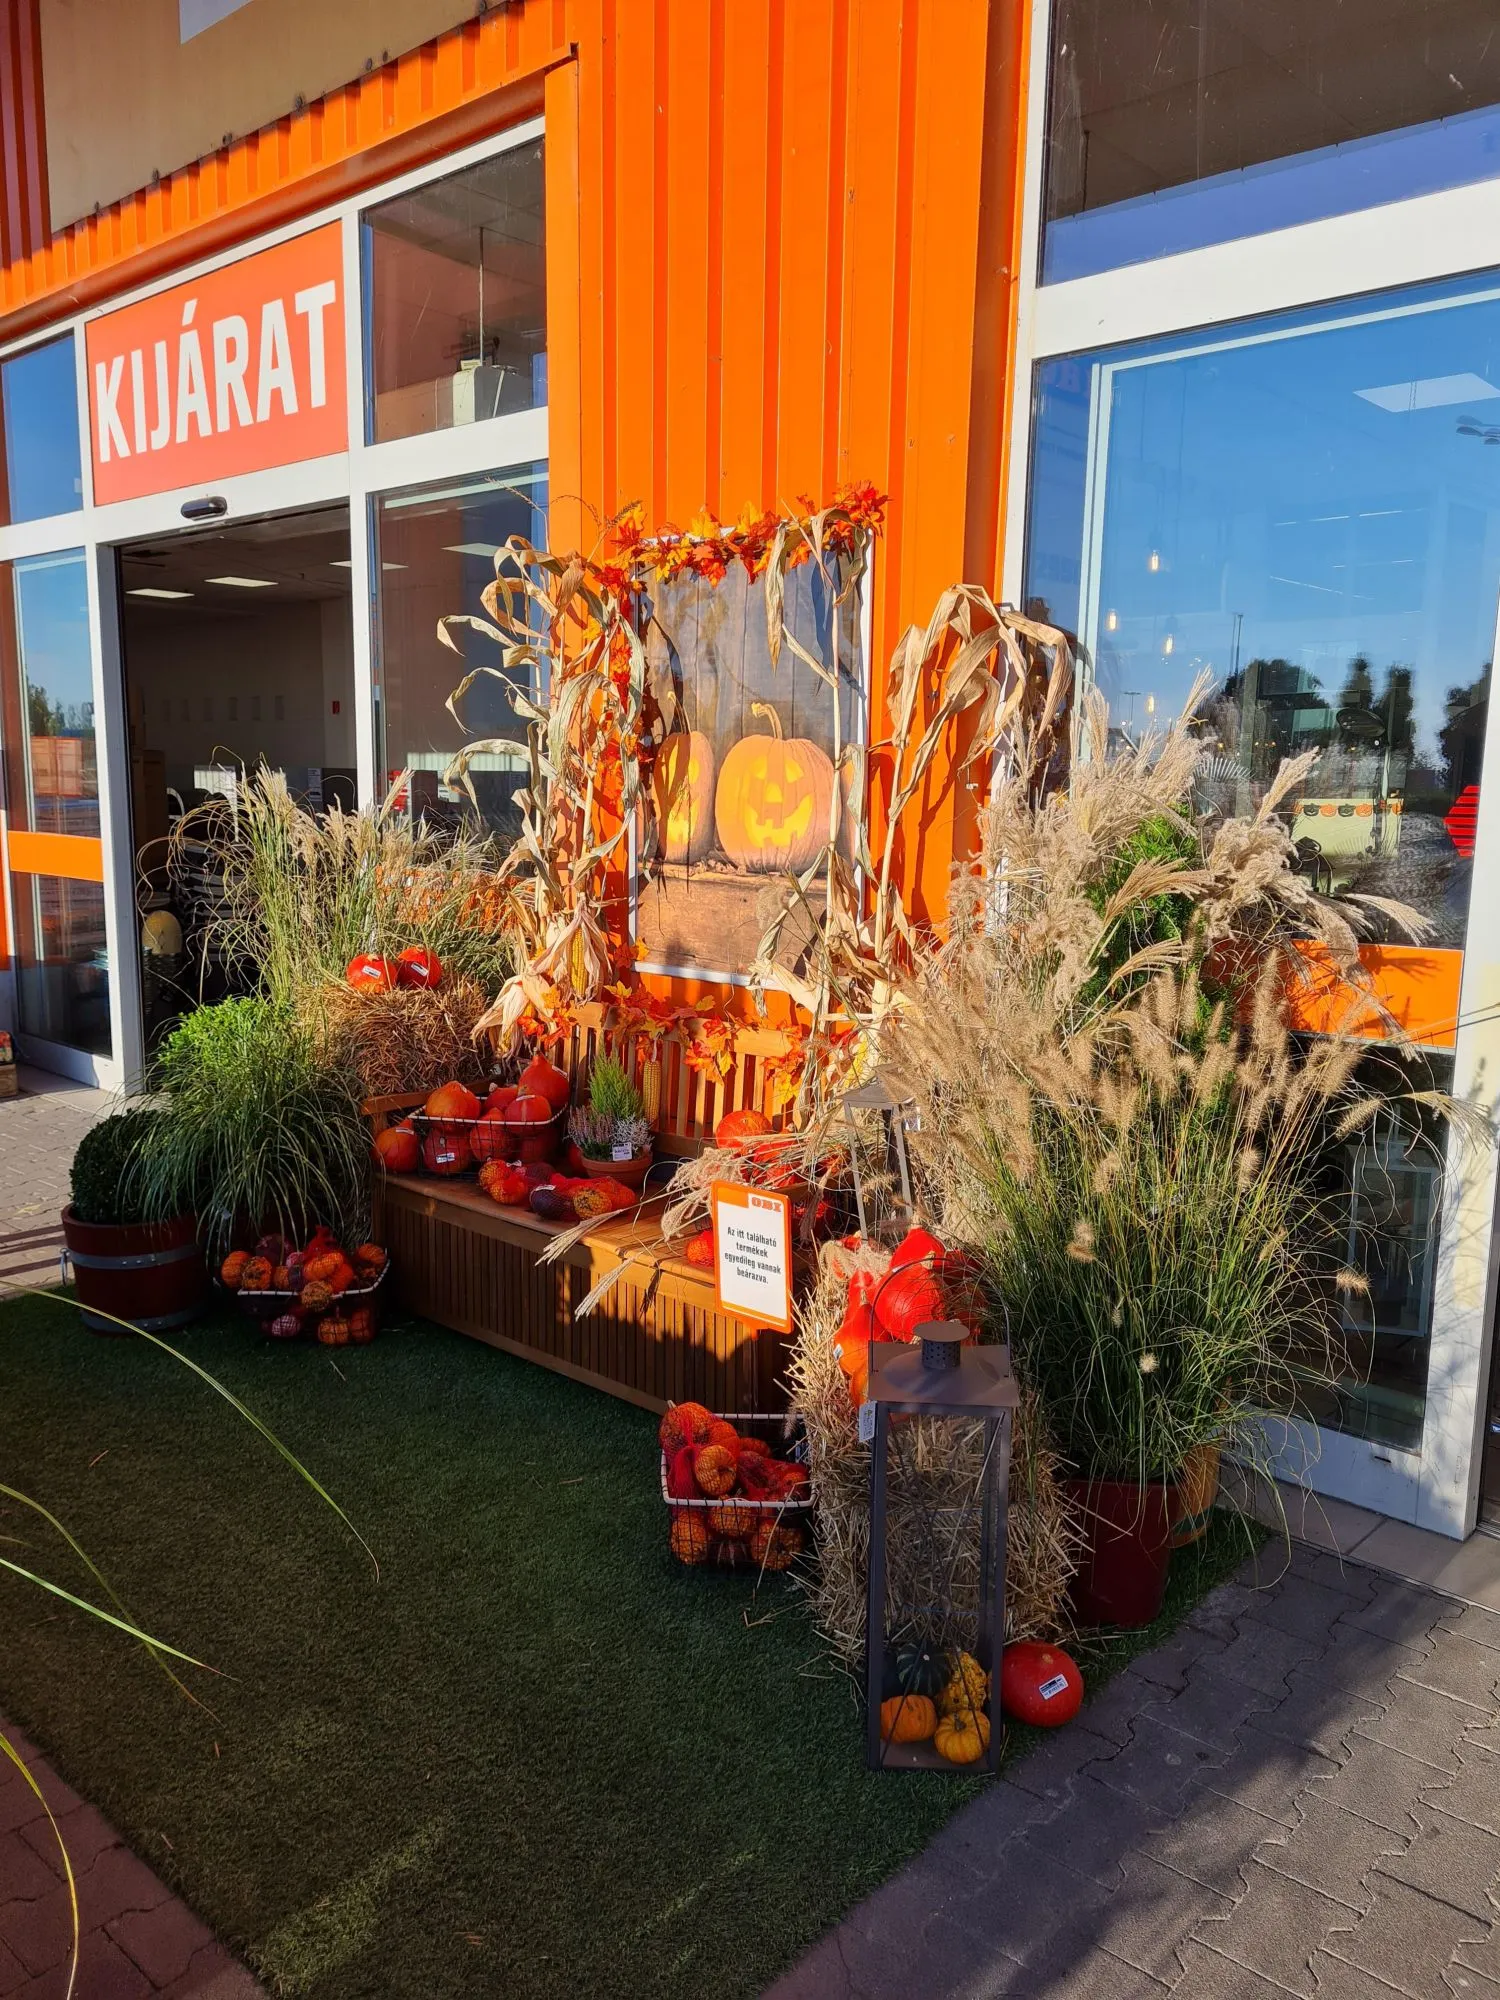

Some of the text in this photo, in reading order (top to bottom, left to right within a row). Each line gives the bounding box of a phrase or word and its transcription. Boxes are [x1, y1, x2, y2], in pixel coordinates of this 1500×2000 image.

[95, 280, 337, 463] KIJÁRAT
[727, 1226, 735, 1236] Az
[746, 1231, 777, 1247] található
[736, 1242, 768, 1258] termékek
[724, 1252, 781, 1275] egyedileg vannak
[736, 1267, 769, 1284] beárazva.
